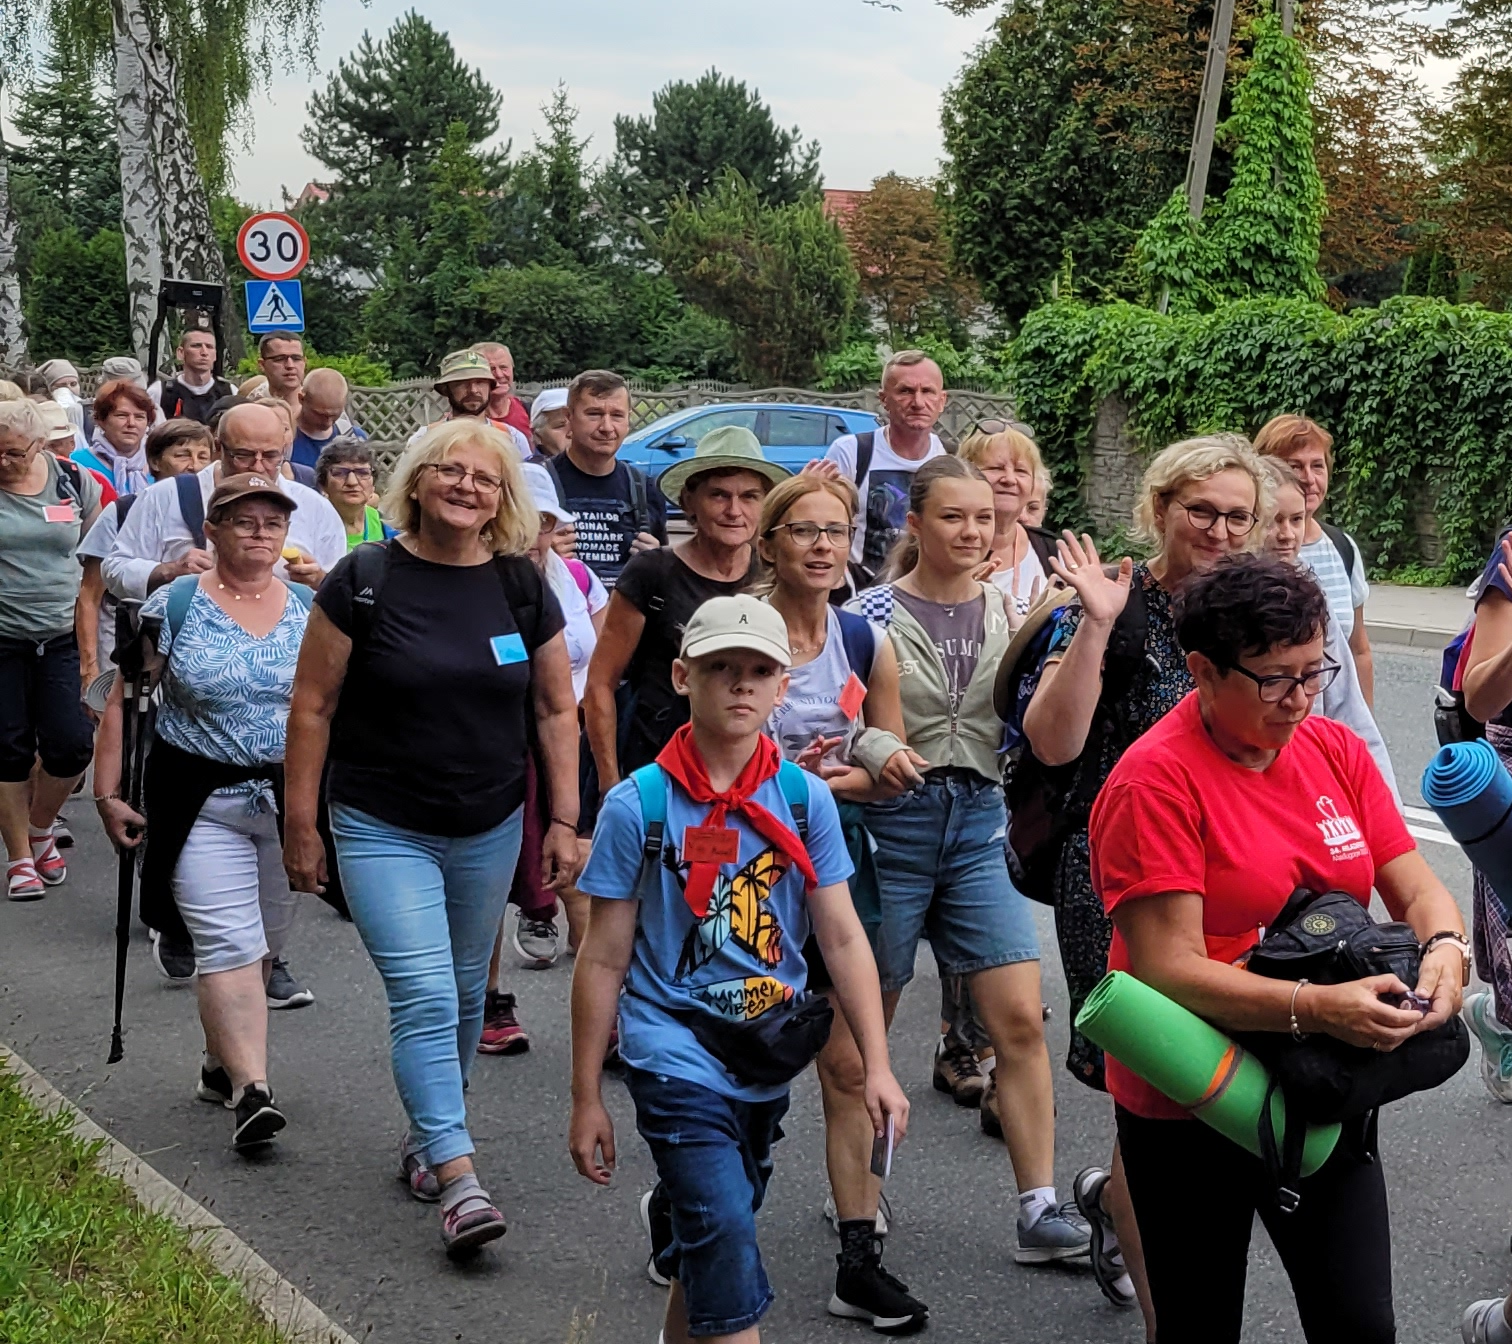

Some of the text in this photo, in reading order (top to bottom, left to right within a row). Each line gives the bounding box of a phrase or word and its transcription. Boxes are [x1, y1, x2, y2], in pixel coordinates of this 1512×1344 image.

[249, 230, 299, 262] 30
[582, 512, 620, 522] TAILOR
[574, 522, 610, 531] IGINAL
[575, 531, 625, 542] ADEMARK
[575, 542, 620, 552] NDMADE
[578, 552, 622, 562] TEMENT
[738, 613, 749, 625] A
[897, 659, 920, 677] EST
